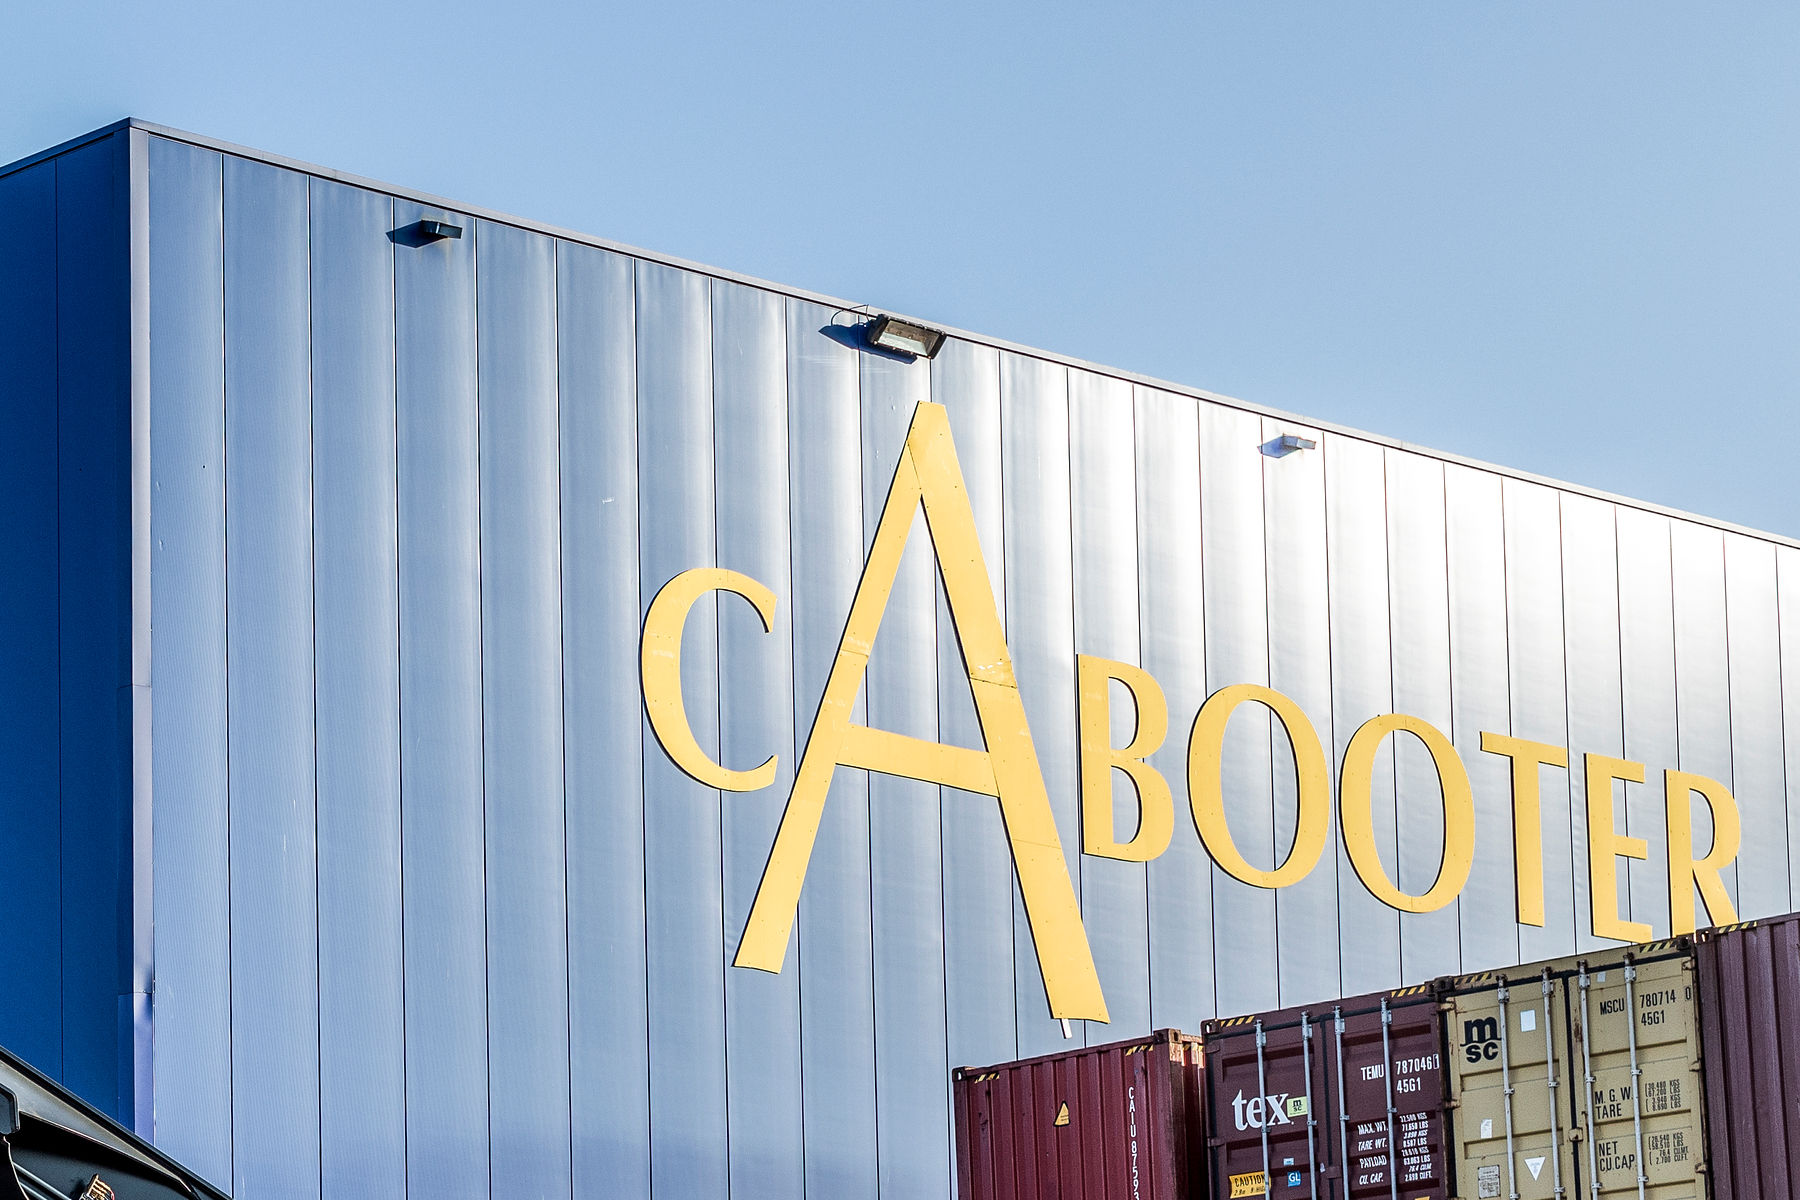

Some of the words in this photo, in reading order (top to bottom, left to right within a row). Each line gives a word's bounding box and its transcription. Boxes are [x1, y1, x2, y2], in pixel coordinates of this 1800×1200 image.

[640, 400, 1741, 1024] CABOOTER
[1600, 998, 1625, 1015] MSCU
[1640, 989, 1676, 1008] 780714
[1641, 1010, 1664, 1026] 45G1
[1361, 1064, 1385, 1081] TEMU
[1396, 1056, 1432, 1075] 787046
[1396, 1077, 1421, 1093] 45G1
[1128, 1087, 1137, 1138] CAIU
[1596, 1103, 1622, 1120] TARE
[1358, 1140, 1373, 1151] TARE
[1599, 1141, 1618, 1157] NET
[1359, 1155, 1387, 1169] PAYLOAD
[1234, 1173, 1265, 1187] CAUTION
[1289, 1173, 1301, 1182] GL
